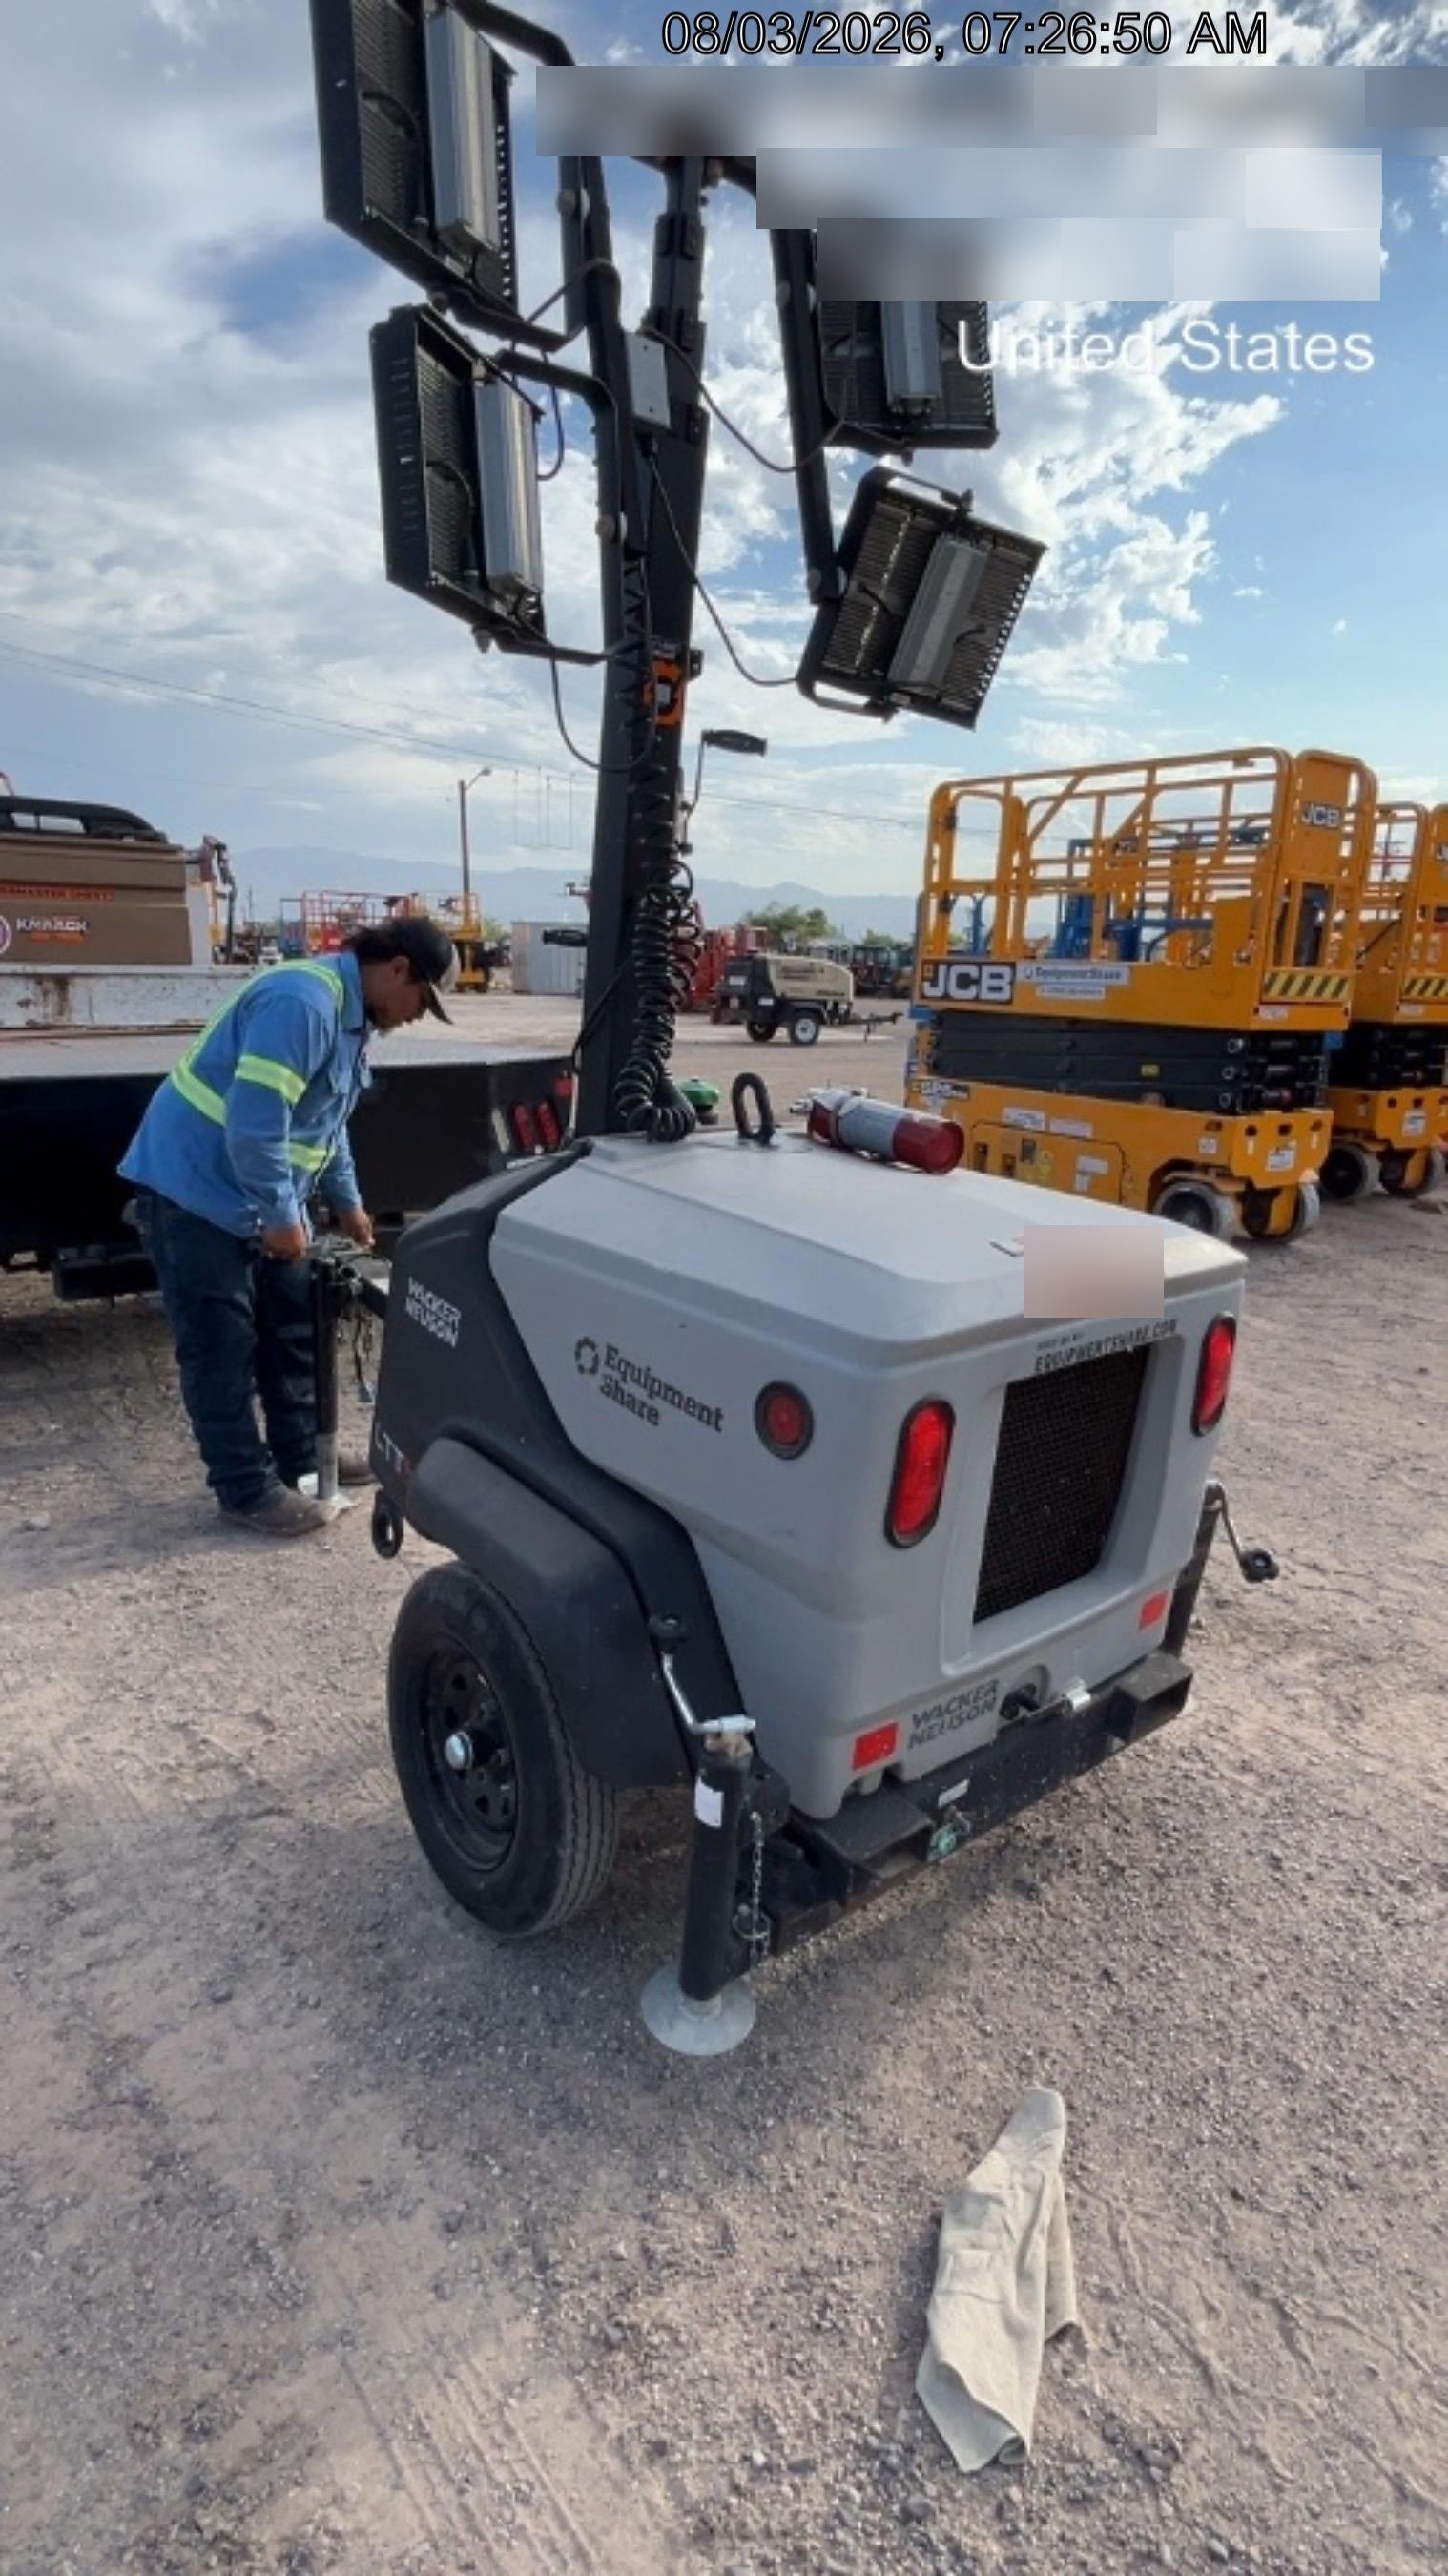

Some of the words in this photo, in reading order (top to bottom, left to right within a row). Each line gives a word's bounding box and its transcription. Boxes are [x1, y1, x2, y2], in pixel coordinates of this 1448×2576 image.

[1301, 804, 1340, 828] JCB
[922, 963, 1014, 1001] JCB
[600, 1374, 660, 1426] Share
[605, 1342, 724, 1432] Equipment
[908, 1698, 996, 1749] NEUSON
[912, 1678, 1000, 1729] WACKER
